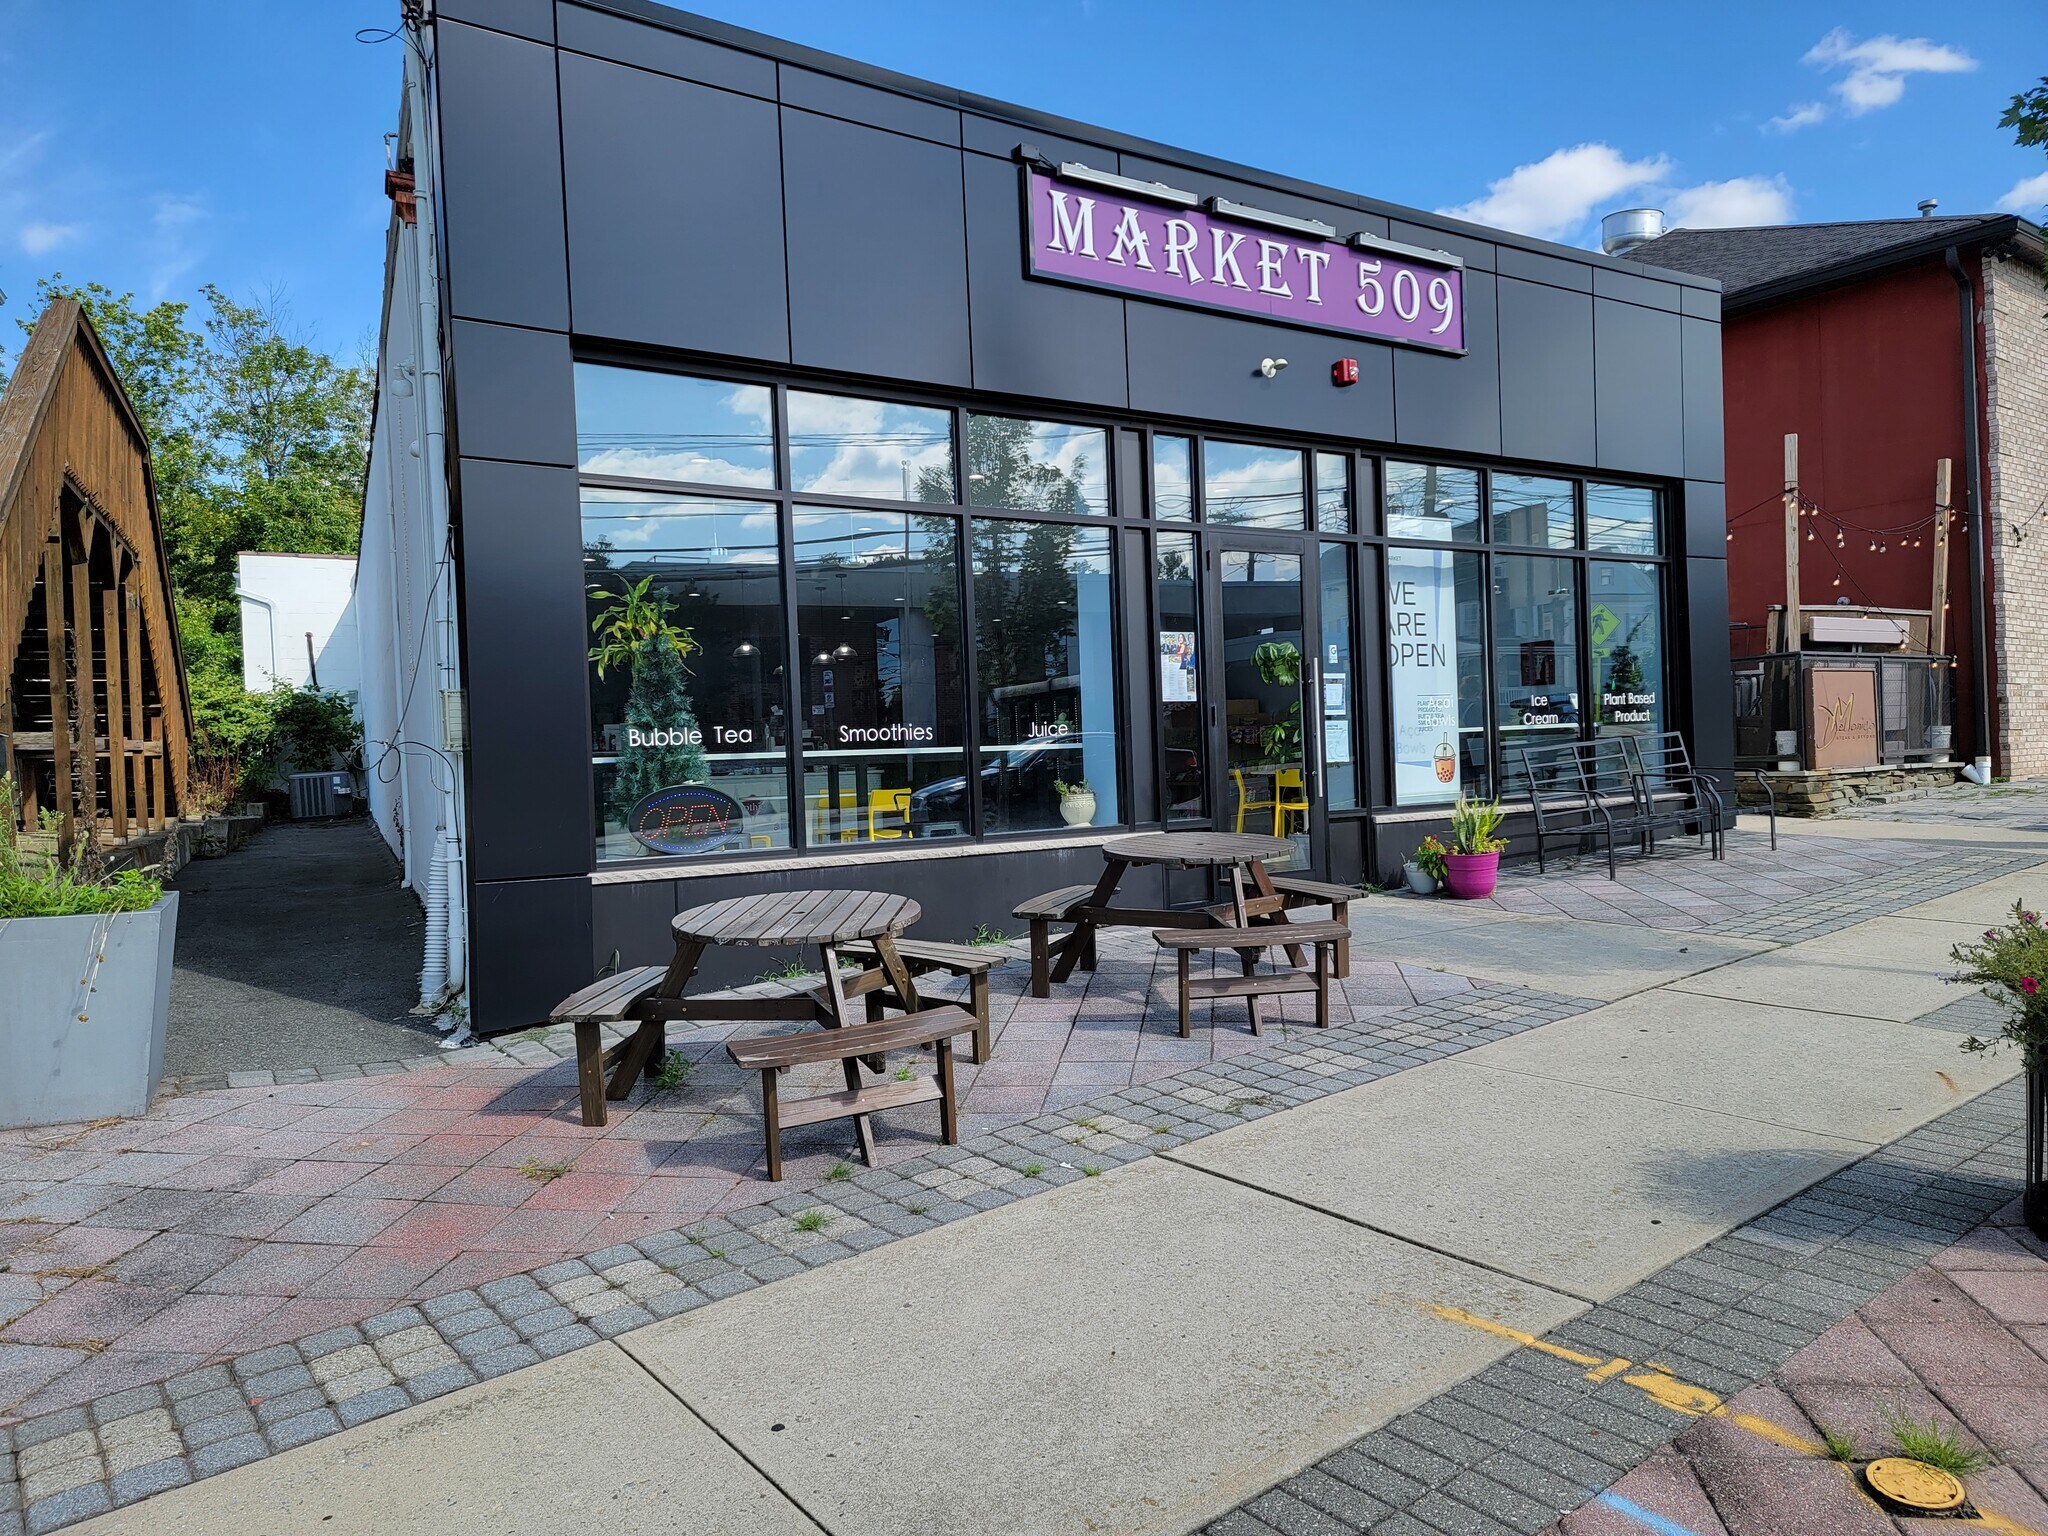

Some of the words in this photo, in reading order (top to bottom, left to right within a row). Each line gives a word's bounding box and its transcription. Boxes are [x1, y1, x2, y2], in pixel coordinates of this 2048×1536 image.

[1047, 189, 1331, 306] MARKET
[1356, 259, 1454, 335] 509
[1530, 694, 1548, 707] Ice
[1603, 693, 1626, 706] Plant
[1628, 692, 1656, 704] Based
[1523, 713, 1559, 725] Cream
[1614, 709, 1651, 722] Product
[628, 727, 703, 747] Bubble
[713, 726, 753, 744] Tea
[839, 723, 934, 743] Smoothies
[1027, 721, 1069, 738] Juice
[639, 801, 733, 840] OPEN
